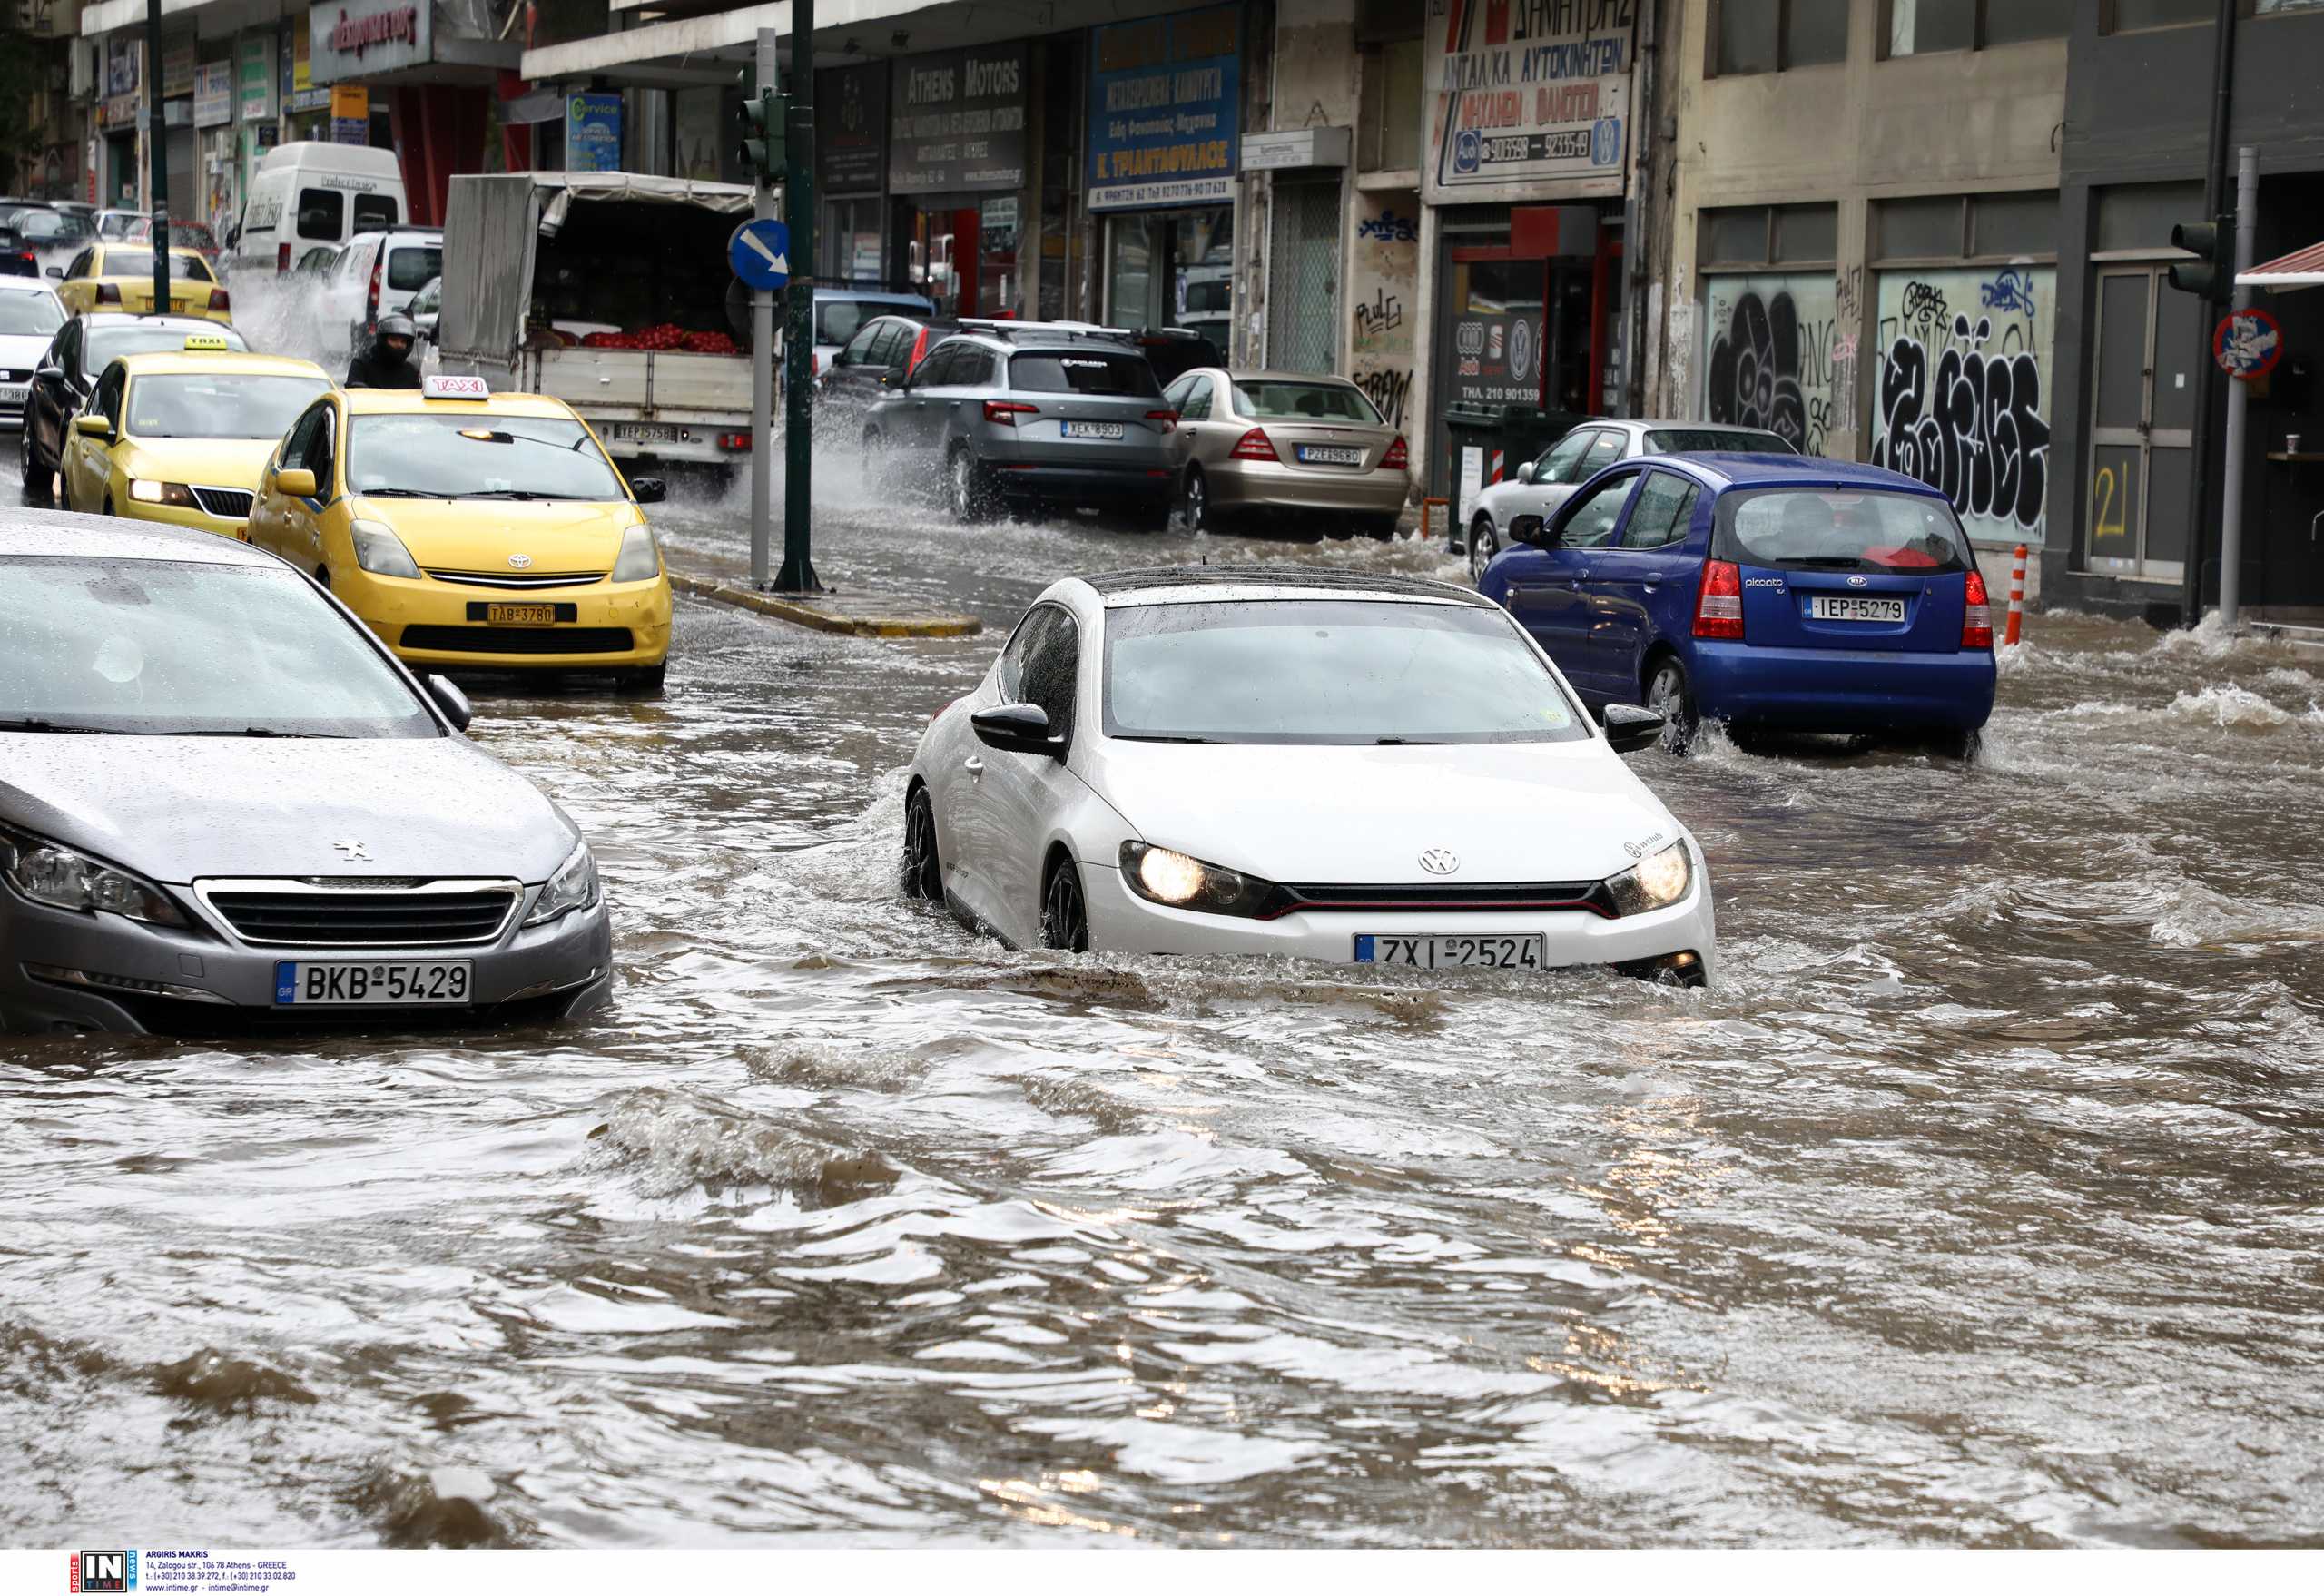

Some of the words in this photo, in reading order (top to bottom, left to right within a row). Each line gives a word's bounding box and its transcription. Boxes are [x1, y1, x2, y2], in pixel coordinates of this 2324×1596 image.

[436, 378, 483, 393] TAXI
[1486, 387, 1503, 400] 210
[1504, 389, 1541, 402] 901359
